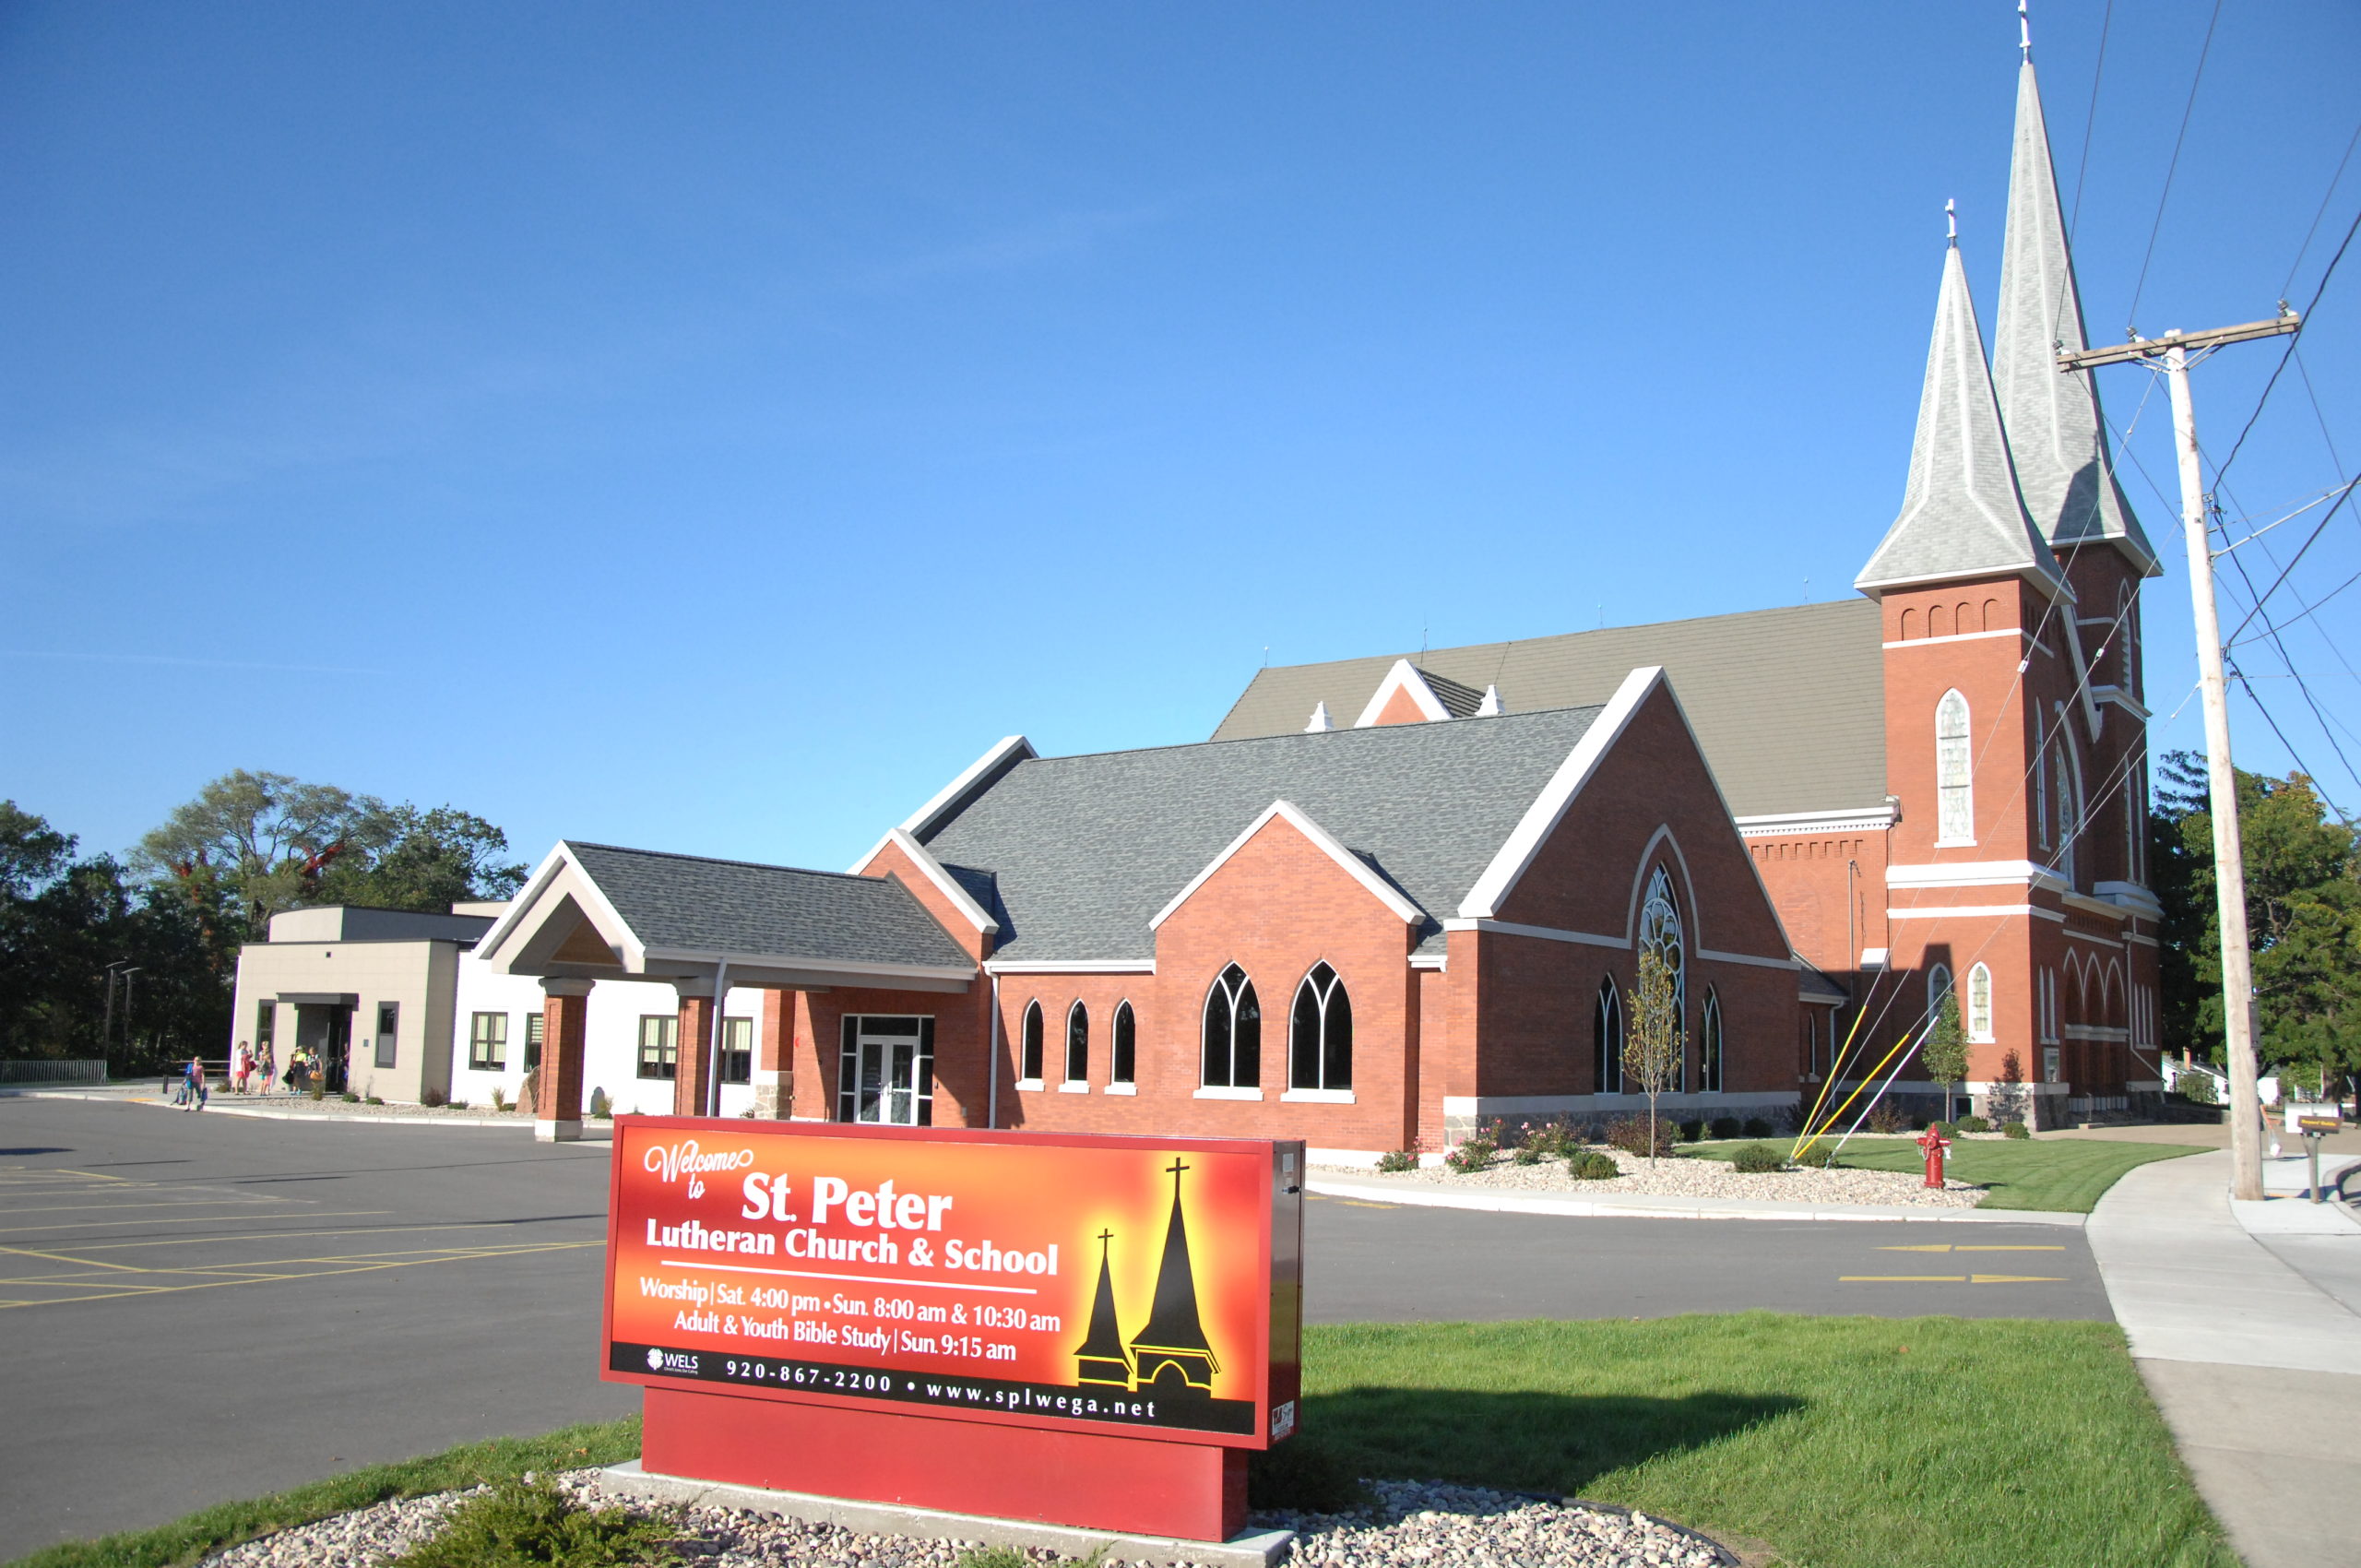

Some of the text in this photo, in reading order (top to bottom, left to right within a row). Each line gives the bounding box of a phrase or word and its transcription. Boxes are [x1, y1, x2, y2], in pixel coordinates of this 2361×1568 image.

[644, 1139, 753, 1182] Welcome
[687, 1172, 706, 1200] to
[742, 1171, 953, 1231] St. Peter
[646, 1218, 1059, 1276] Lutheran Church & School
[640, 1276, 1061, 1333] Worship Sat. 4:00 pm Sun. 8:00 am & 10:30 am
[664, 1353, 698, 1370] WELS
[673, 1310, 1017, 1361] Adult & Youth Bible Study Sun. 9:15 am
[726, 1360, 1156, 1419] 920-867-2200 www.splwega.net
